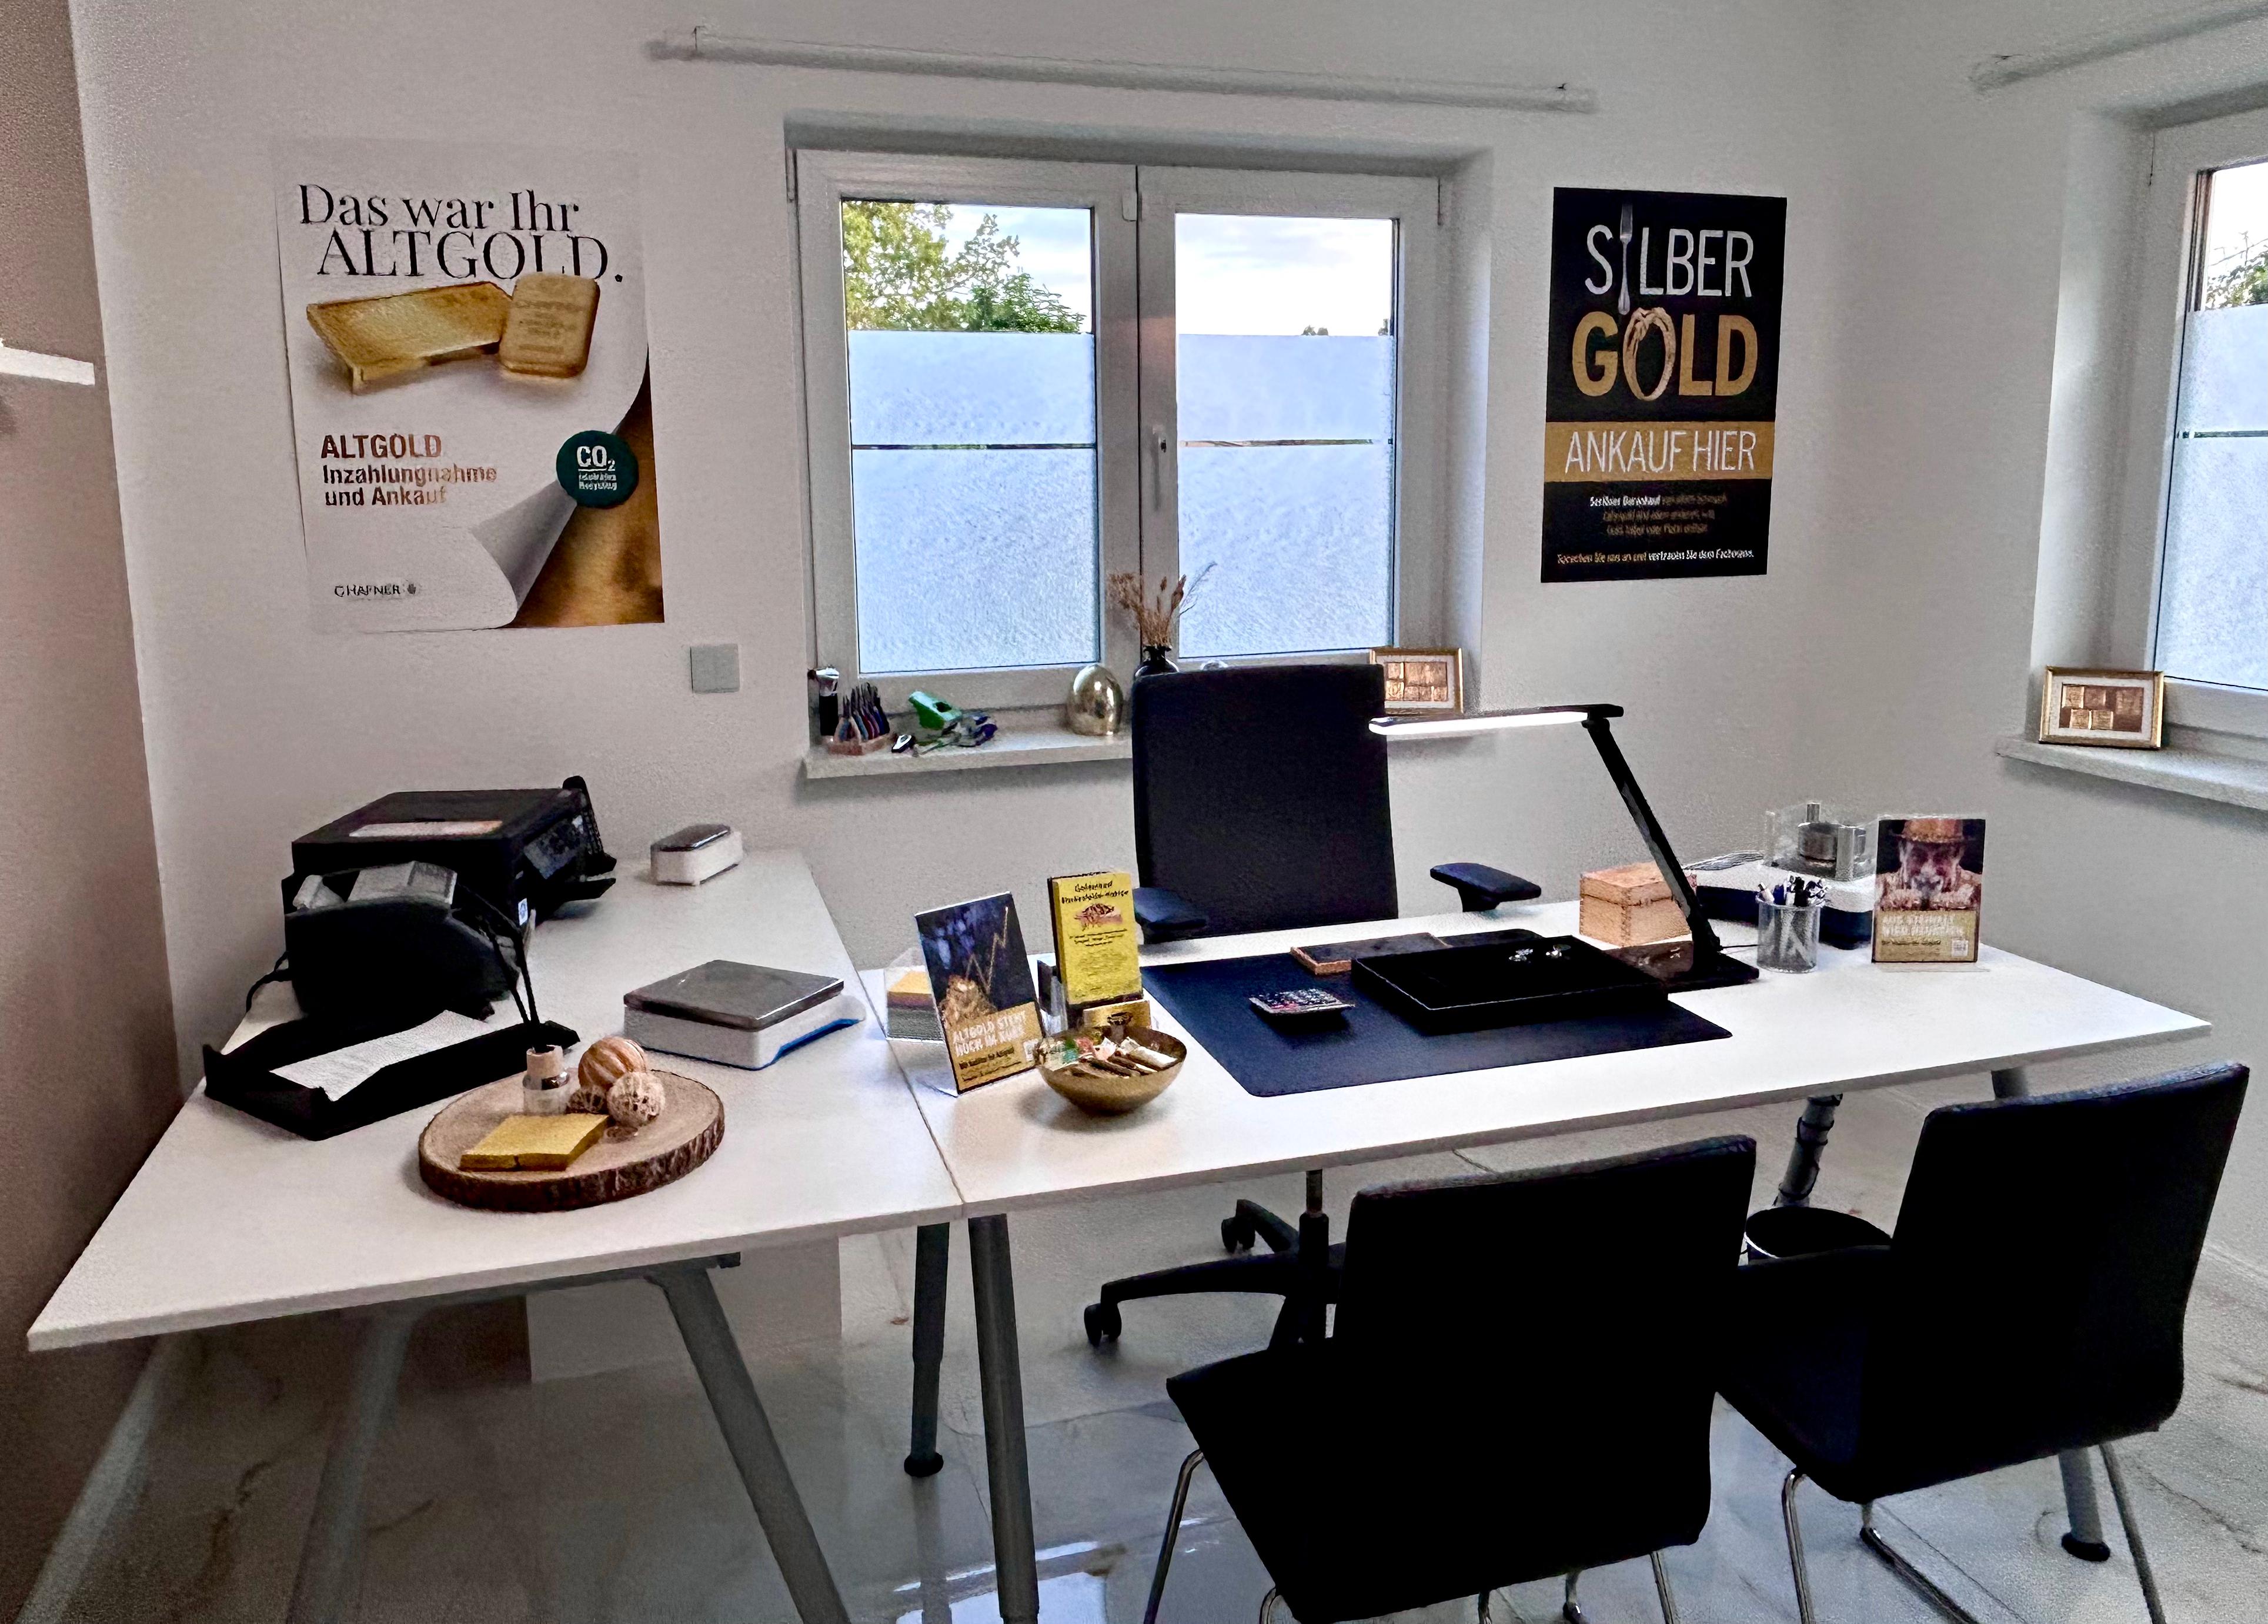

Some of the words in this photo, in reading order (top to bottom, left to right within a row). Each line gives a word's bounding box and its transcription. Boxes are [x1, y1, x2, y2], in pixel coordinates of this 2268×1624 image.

[299, 184, 388, 226] Das
[402, 196, 494, 229] war
[509, 189, 579, 231] Ihr
[317, 229, 623, 282] ALTGOLD.
[1572, 306, 1758, 402] GOLD
[321, 433, 442, 459] ALTGOLD
[1565, 430, 1687, 475] ANKAUF
[1694, 430, 1756, 472] HIER
[323, 463, 497, 487] Inzahlungnahme
[325, 487, 365, 506] und
[372, 486, 447, 506] Ankauf
